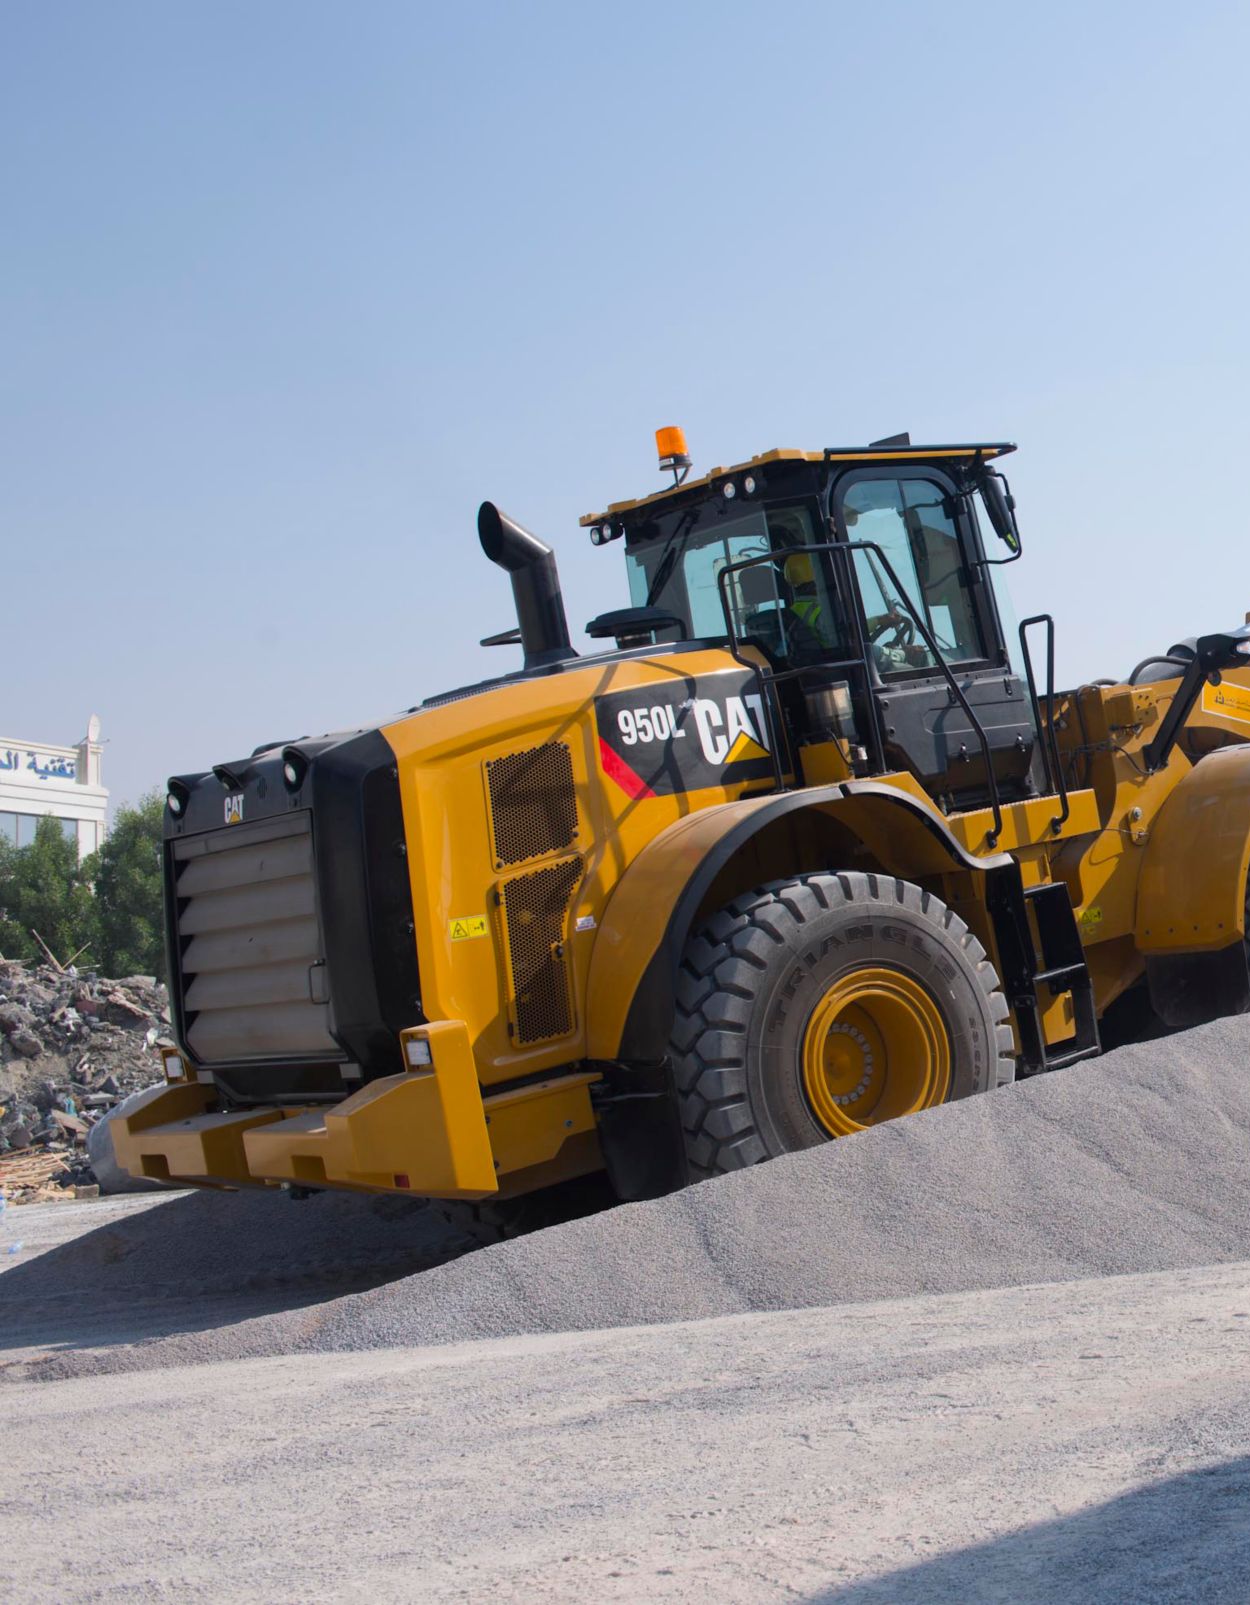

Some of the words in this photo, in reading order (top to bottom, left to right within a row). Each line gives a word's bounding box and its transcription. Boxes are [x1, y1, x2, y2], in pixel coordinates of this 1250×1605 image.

[618, 705, 685, 745] 950L
[693, 694, 770, 765] CAT
[26, 752, 76, 780] تقنية
[224, 794, 244, 824] CAT
[768, 924, 958, 1034] TRIANGLE
